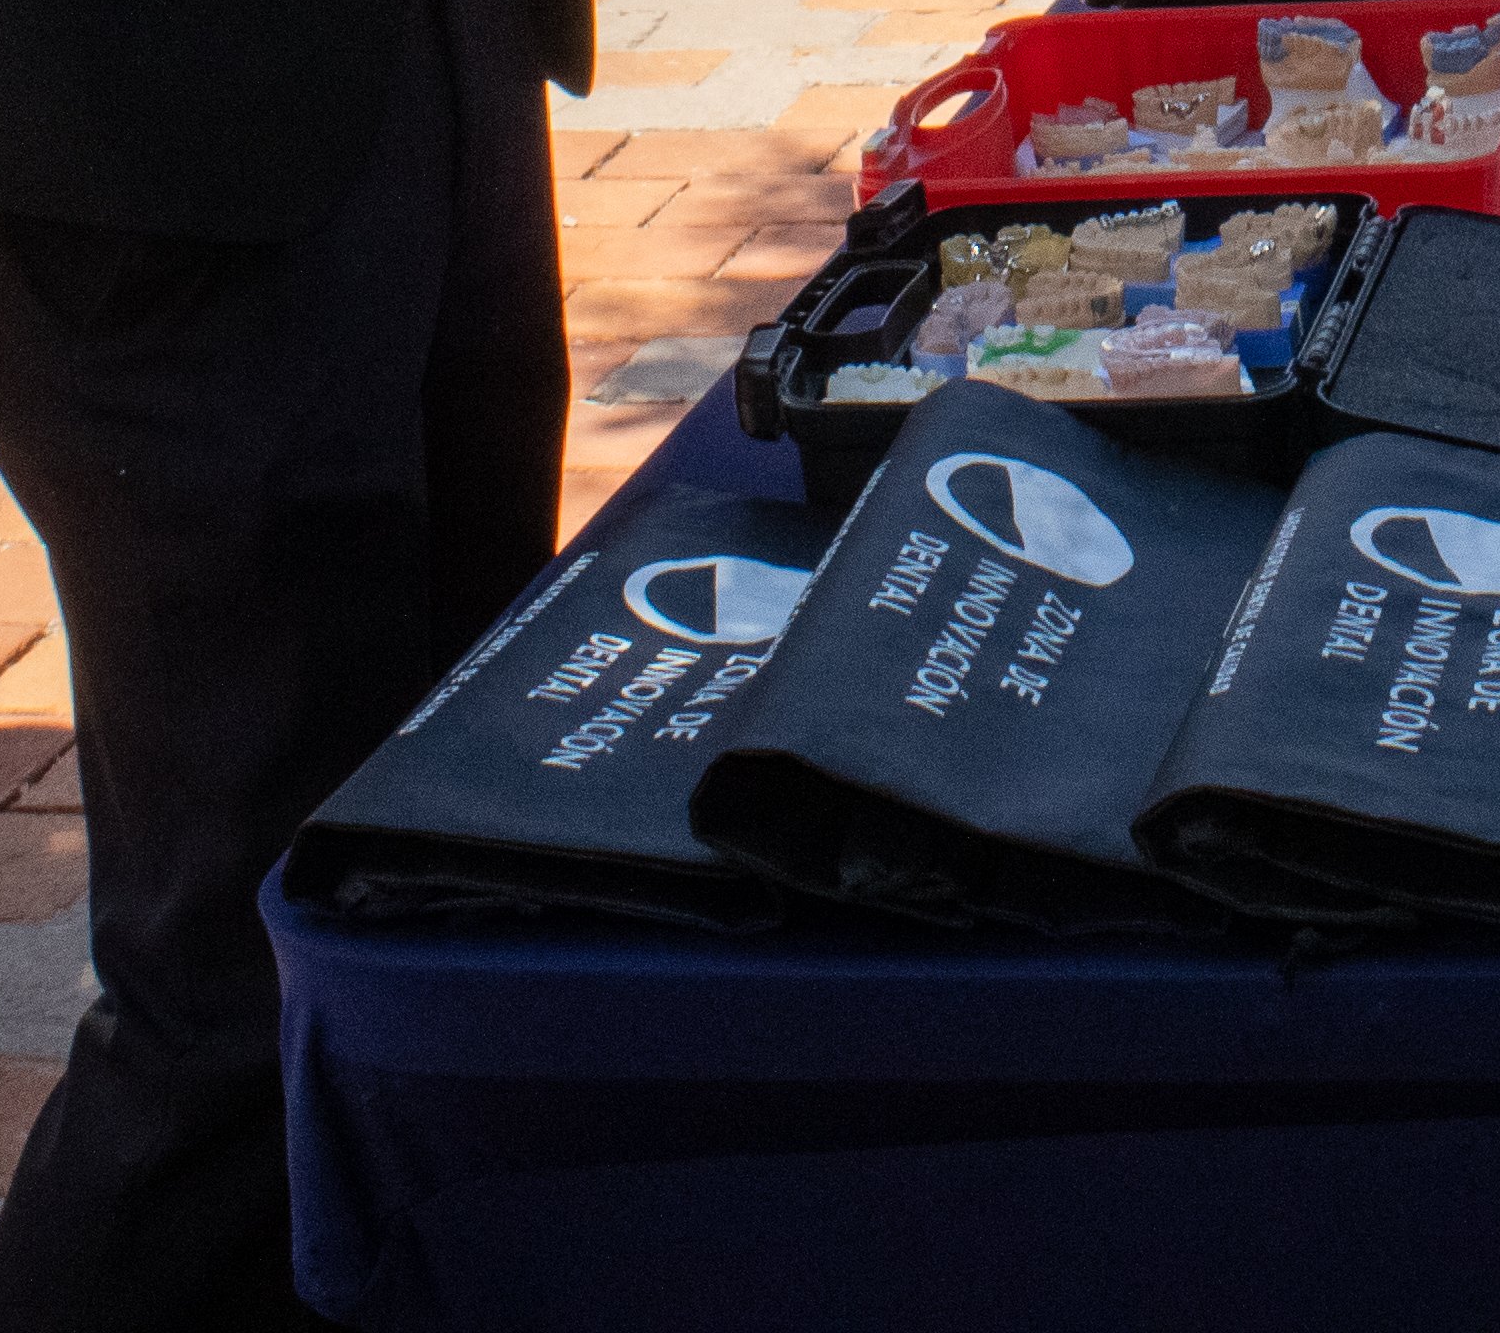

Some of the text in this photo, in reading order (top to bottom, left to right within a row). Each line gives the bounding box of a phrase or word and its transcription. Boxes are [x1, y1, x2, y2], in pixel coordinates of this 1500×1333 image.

[868, 530, 950, 616] DENTAL
[1320, 580, 1389, 662] DENTAL
[526, 632, 634, 704] DENTAL
[904, 556, 1019, 720] INNOVACIÓN
[1000, 590, 1083, 707] ZONA DE
[1375, 596, 1463, 754] INNOVACIÓN
[540, 647, 703, 771] INNOVACIÓN
[653, 711, 713, 741] DE
